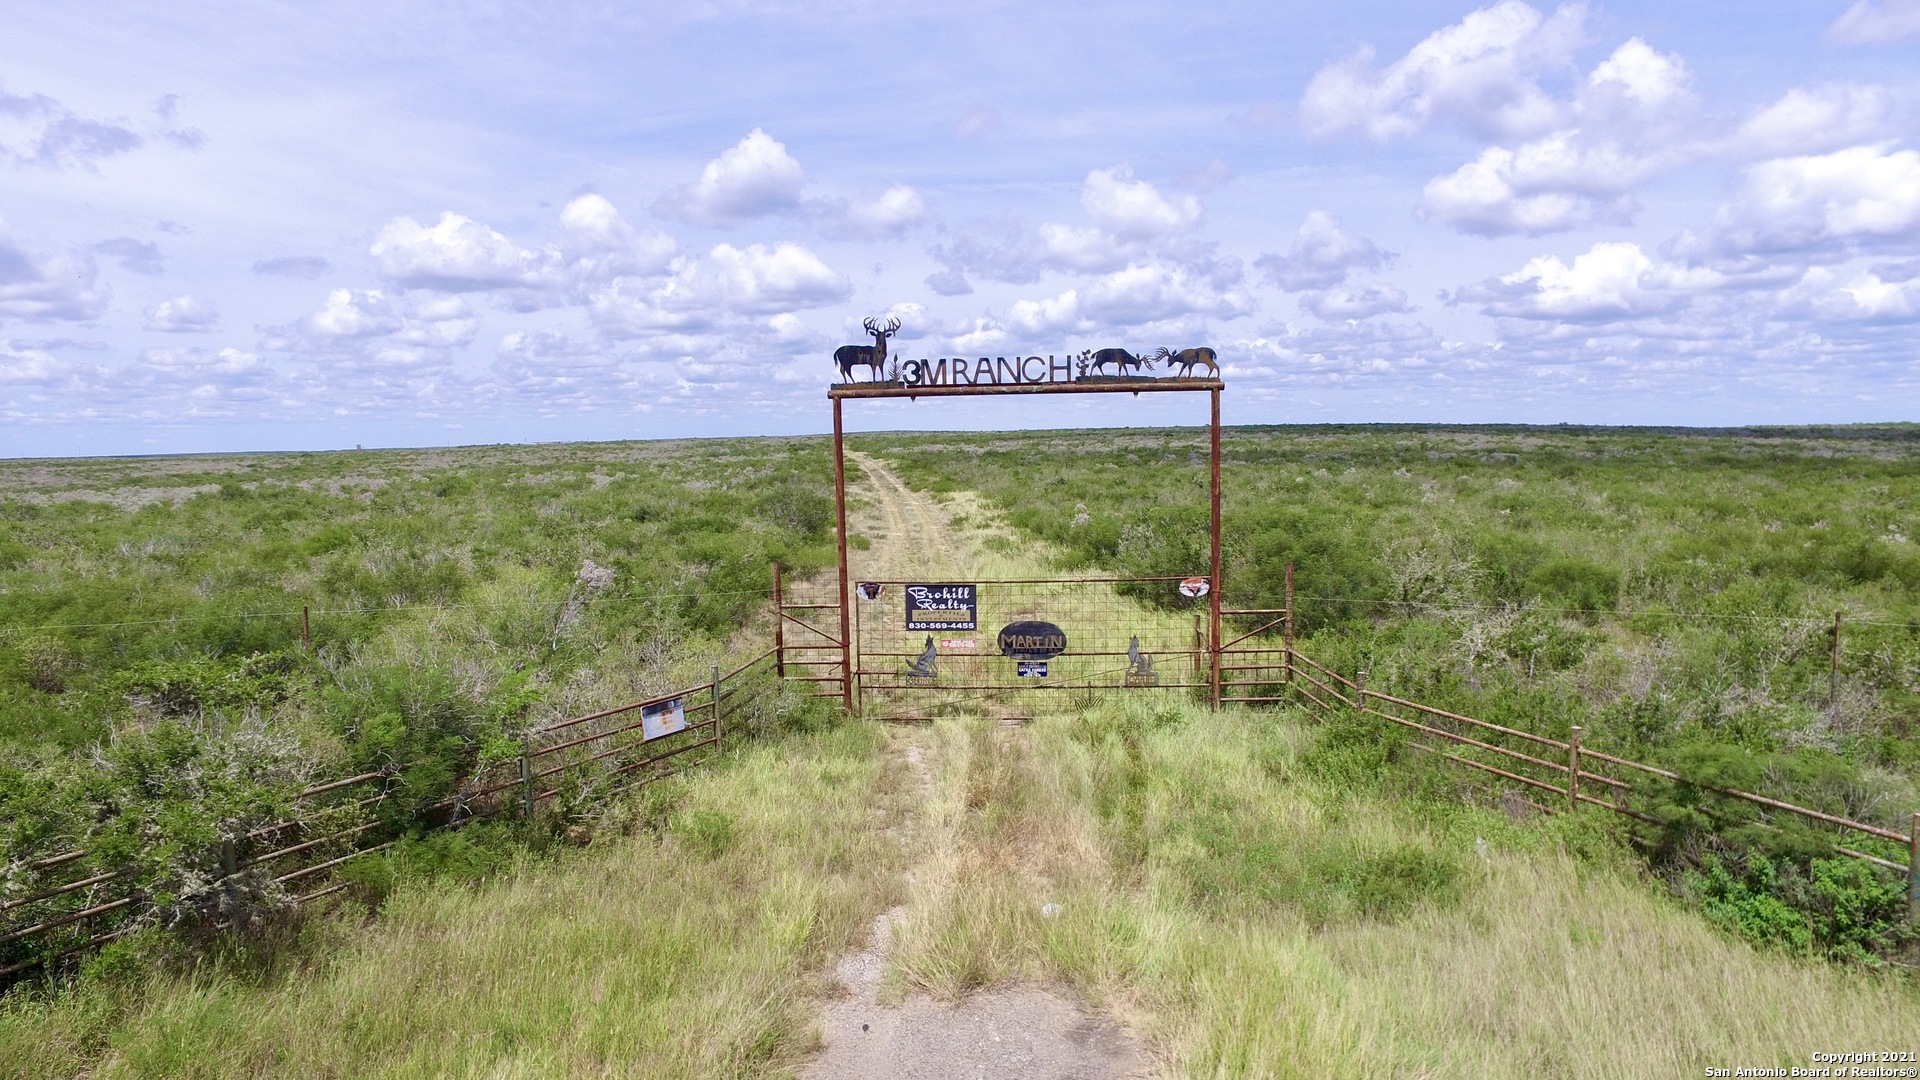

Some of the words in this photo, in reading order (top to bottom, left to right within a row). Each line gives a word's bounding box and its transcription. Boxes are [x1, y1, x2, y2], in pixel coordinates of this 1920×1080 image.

[907, 586, 970, 600] Brohill
[916, 599, 974, 612] Realty
[1001, 634, 1063, 649] MARTIN
